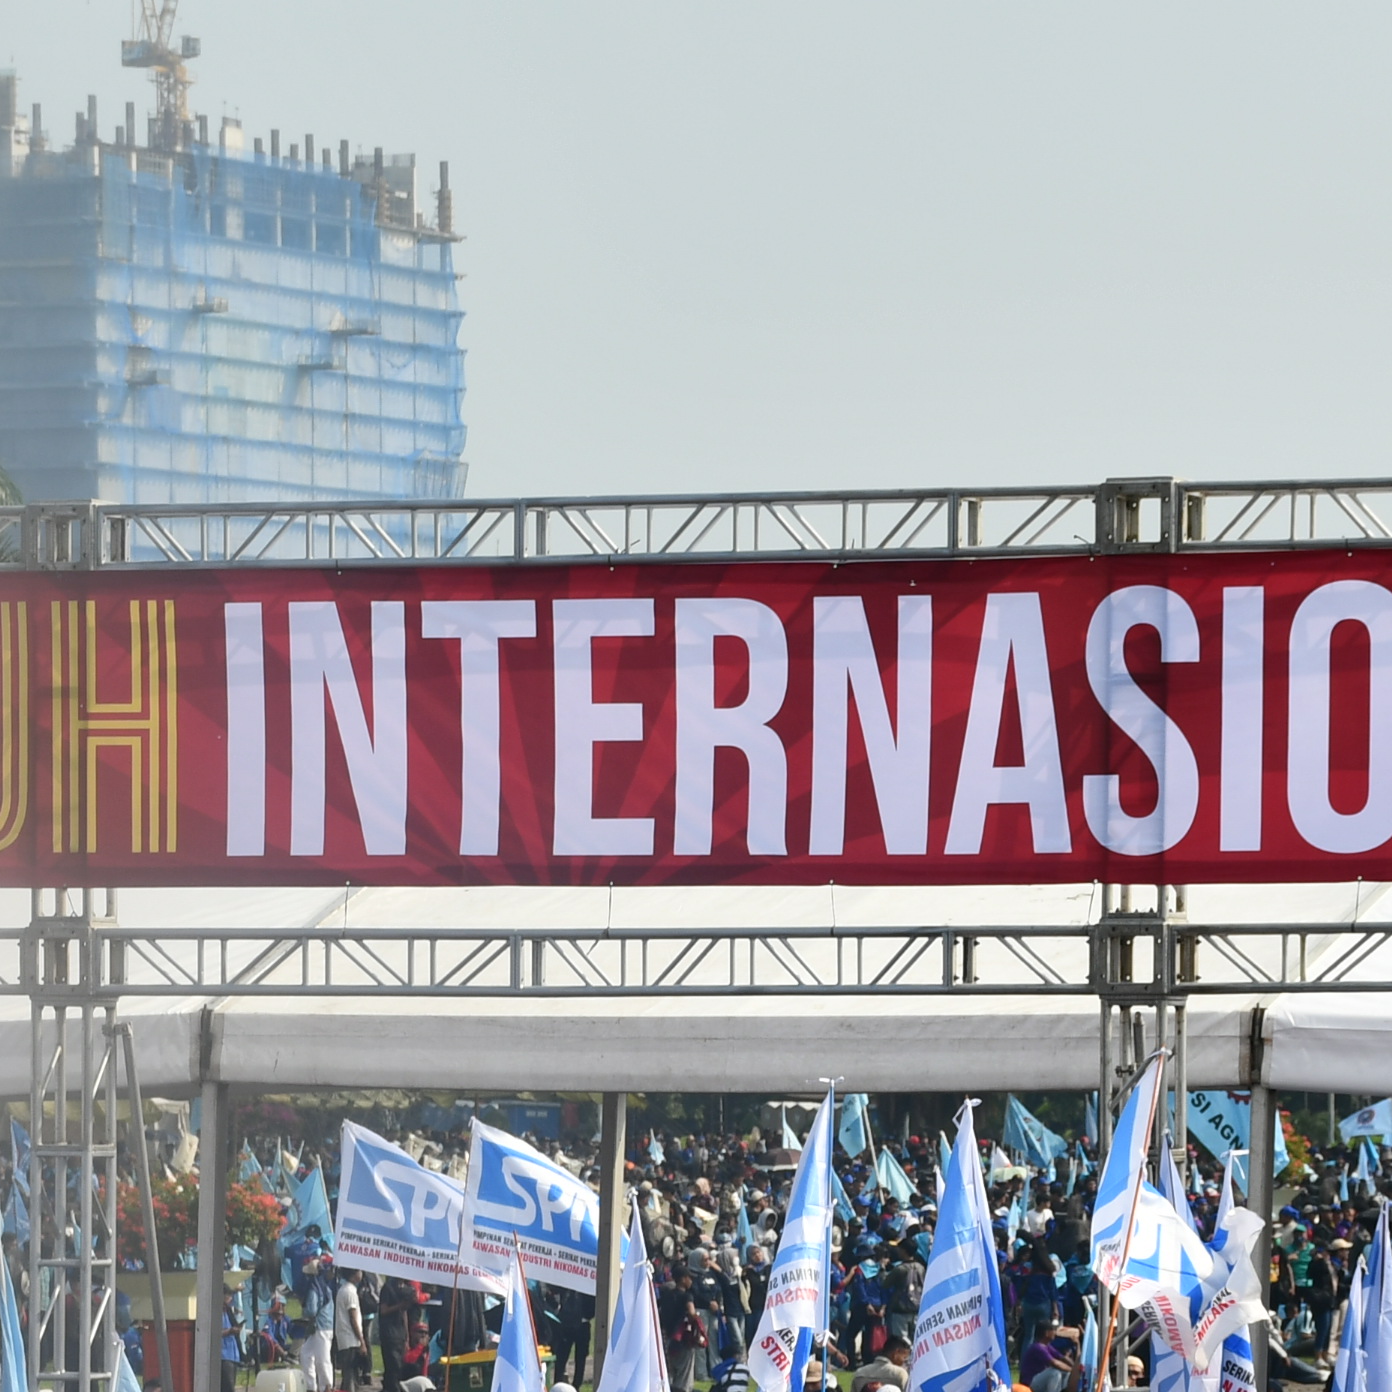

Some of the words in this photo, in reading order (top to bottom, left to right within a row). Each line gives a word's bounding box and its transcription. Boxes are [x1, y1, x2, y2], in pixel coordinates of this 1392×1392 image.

[1189, 1091, 1212, 1114] SI
[340, 1230, 372, 1246] PIMPINAN
[372, 1236, 398, 1251] SERIKAT
[527, 1241, 553, 1257] PEKERJA
[338, 1241, 382, 1260] KAWASAN
[383, 1251, 426, 1269] INDUSTRI
[427, 1261, 470, 1276] NIKOMAS
[472, 1241, 512, 1258] KAWASAN
[516, 1250, 552, 1268] NDUSTRI
[553, 1261, 589, 1278] NIKOMAS
